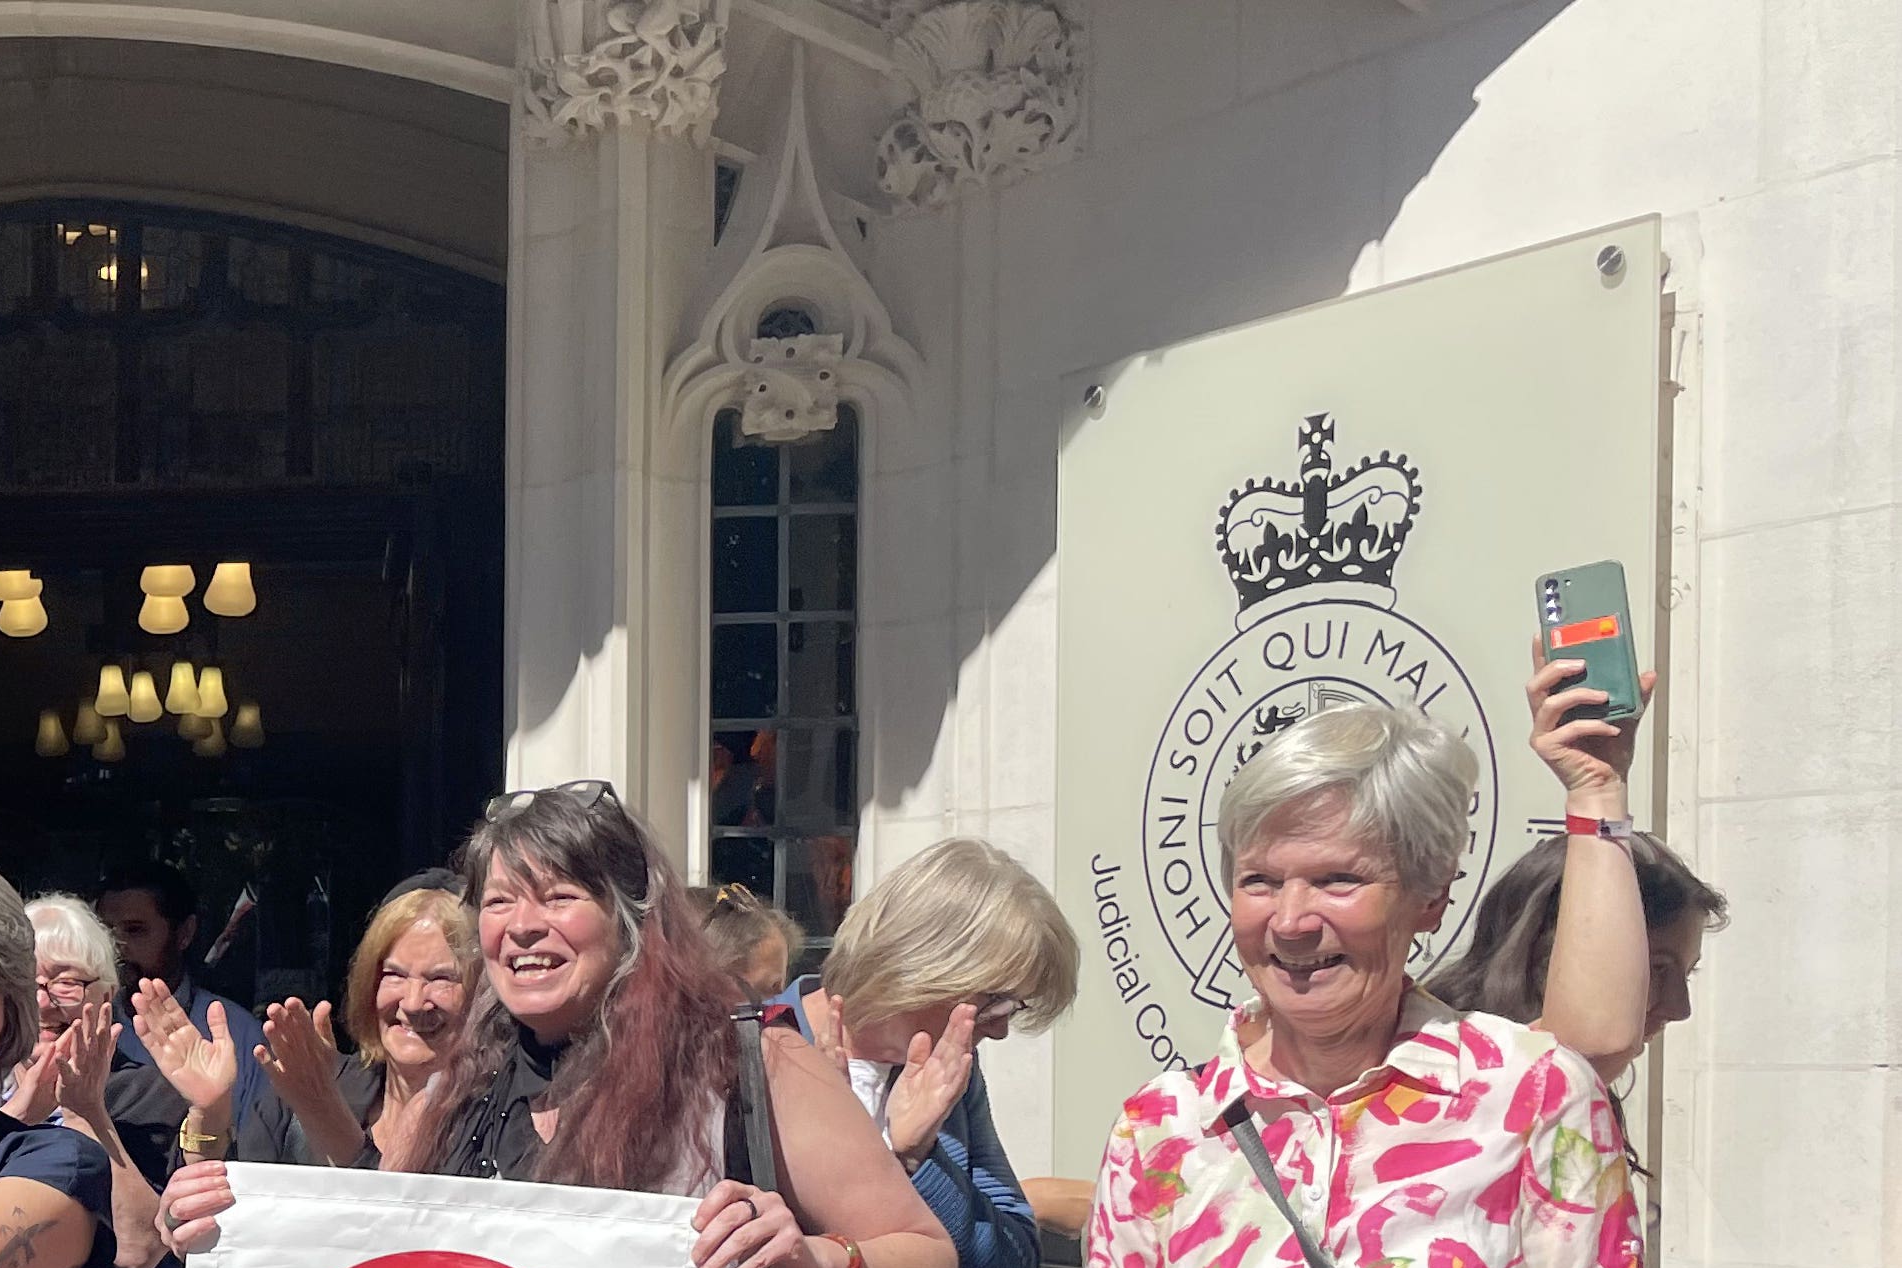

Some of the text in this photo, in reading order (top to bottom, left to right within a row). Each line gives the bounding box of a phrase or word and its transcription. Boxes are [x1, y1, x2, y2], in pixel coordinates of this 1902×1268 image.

[1159, 620, 1448, 939] HONI SOIT QUI MAL
[1091, 854, 1151, 1003] Judicial
